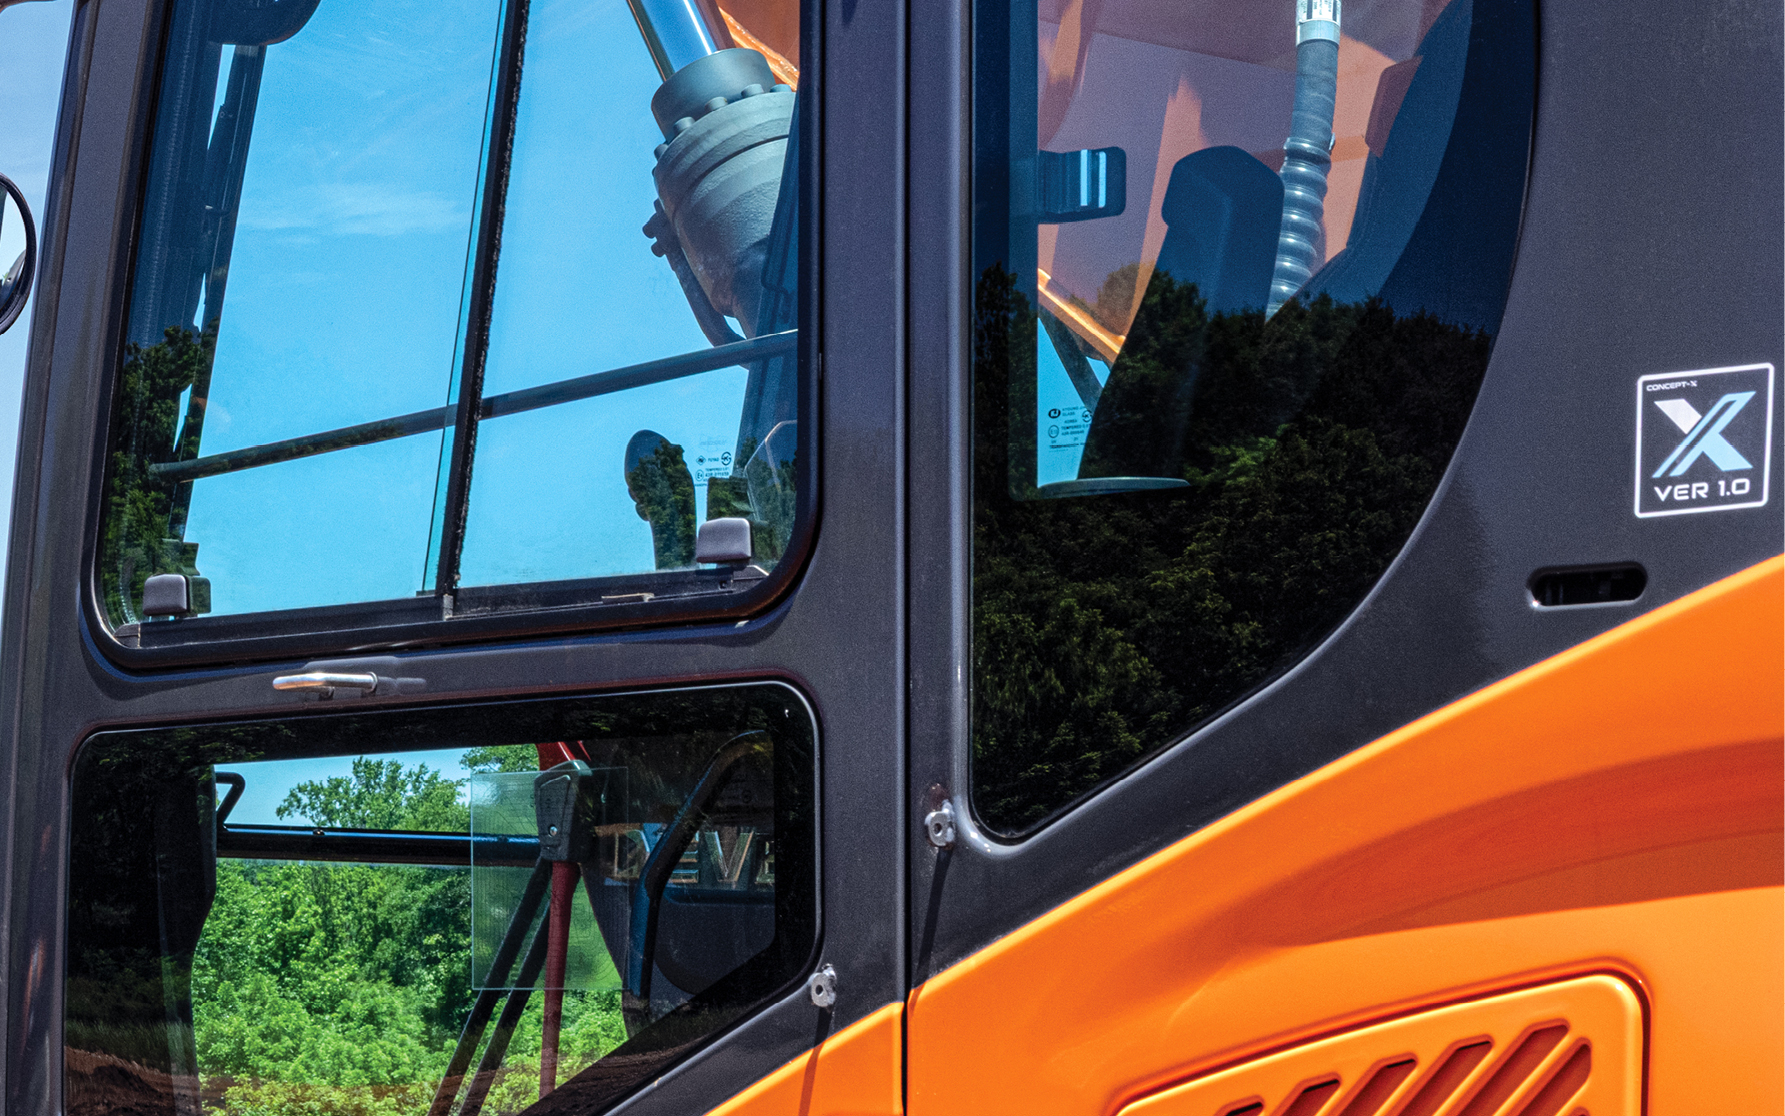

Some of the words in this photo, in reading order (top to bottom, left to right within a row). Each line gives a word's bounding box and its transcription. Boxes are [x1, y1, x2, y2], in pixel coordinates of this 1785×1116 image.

[1646, 380, 1698, 392] CONCEPT-X
[1654, 481, 1709, 502] VER
[1718, 478, 1751, 497] 1.0
